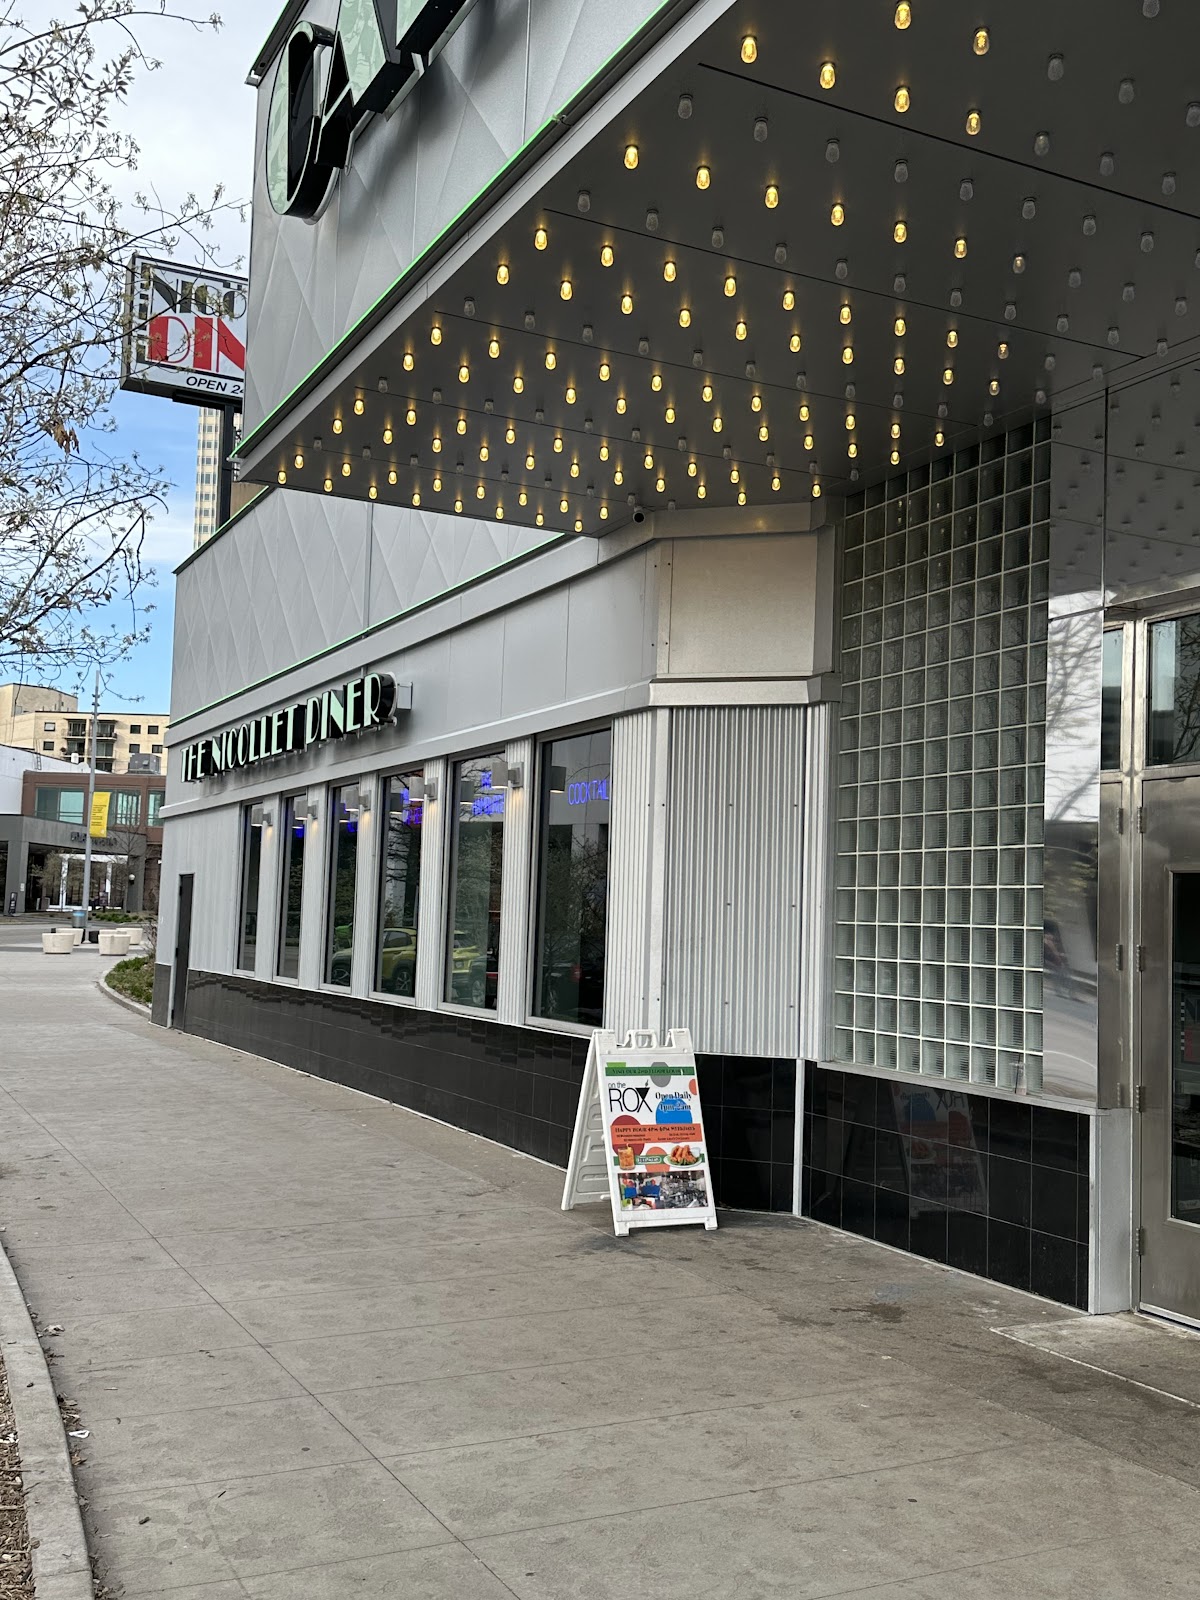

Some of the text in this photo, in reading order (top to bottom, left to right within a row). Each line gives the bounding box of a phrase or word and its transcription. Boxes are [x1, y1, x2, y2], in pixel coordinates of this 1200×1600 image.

[186, 376, 227, 392] OPEN
[180, 672, 383, 783] THE NICOLLET DINER
[616, 1081, 626, 1089] the
[609, 1087, 653, 1113] ROX
[655, 1092, 692, 1102] Open Daily
